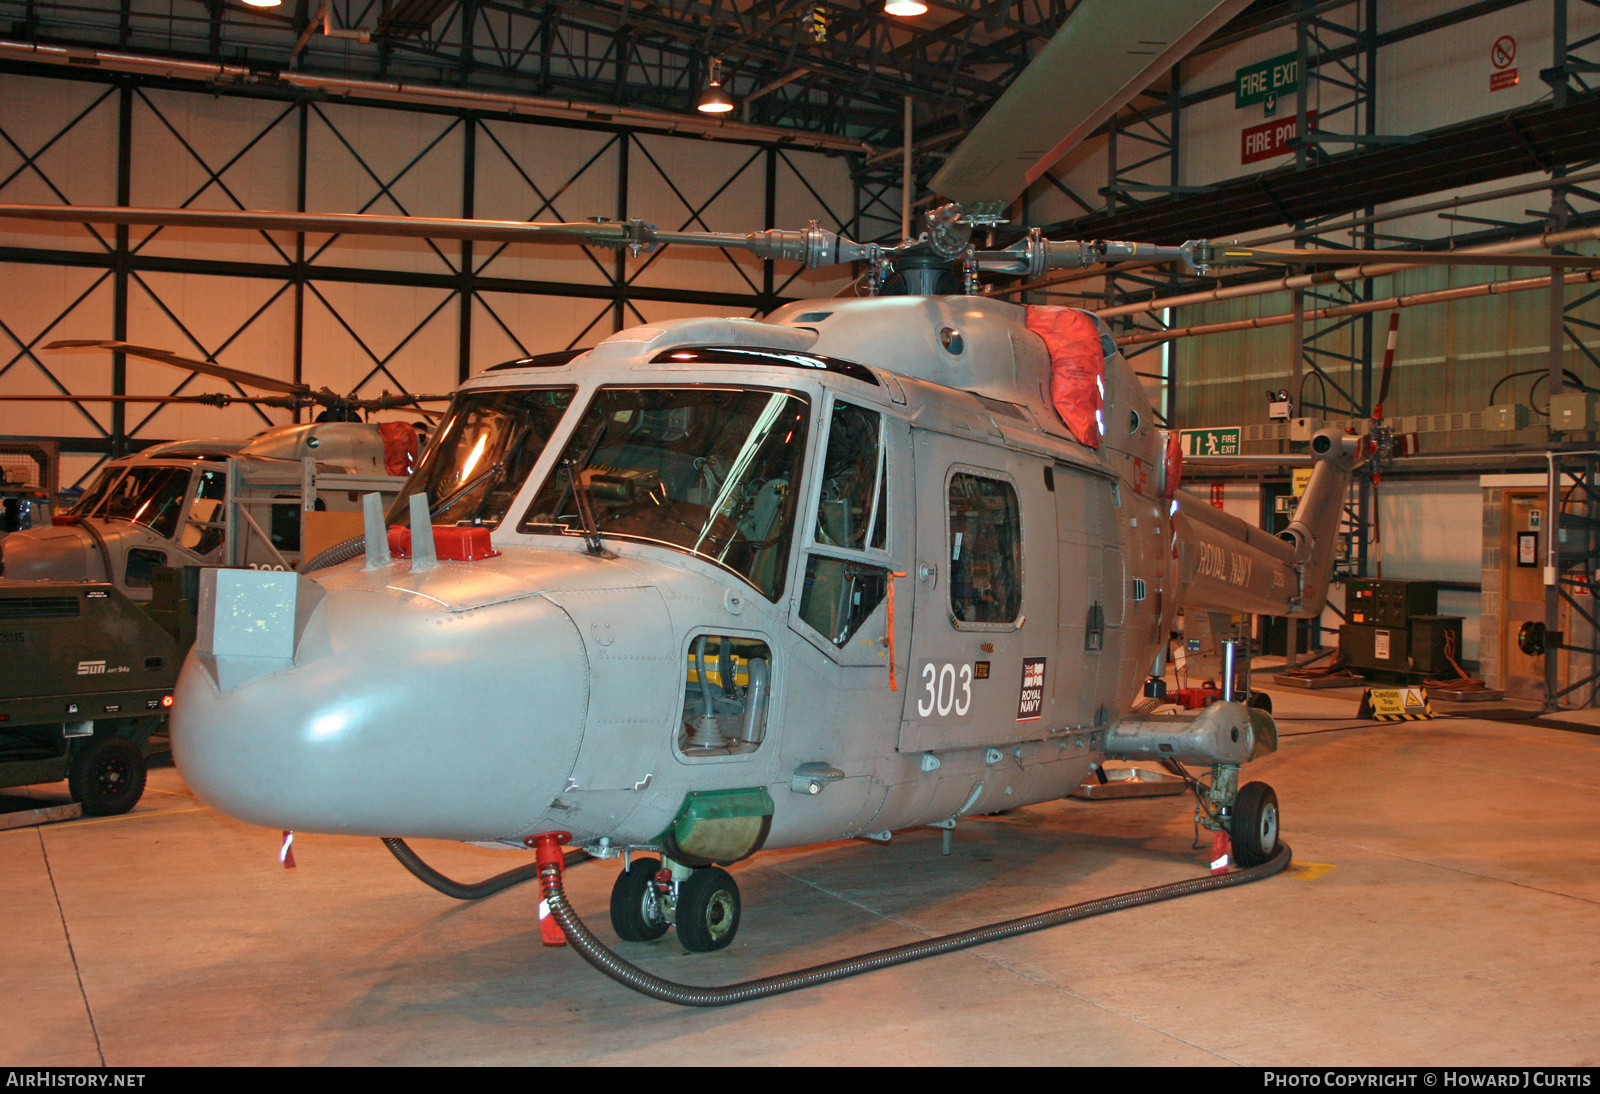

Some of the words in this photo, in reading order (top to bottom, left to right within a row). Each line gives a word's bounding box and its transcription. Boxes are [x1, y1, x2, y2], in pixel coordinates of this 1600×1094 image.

[1241, 70, 1267, 97] FIRE
[1246, 130, 1271, 155] FIRE
[1221, 434, 1237, 443] FIRE
[1221, 445, 1236, 454] EXIT
[1198, 541, 1226, 580] ROYAL
[1229, 552, 1252, 588] NAVY
[918, 663, 972, 717] 303
[1021, 689, 1041, 700] ROYAL
[1020, 700, 1040, 713] NAVY
